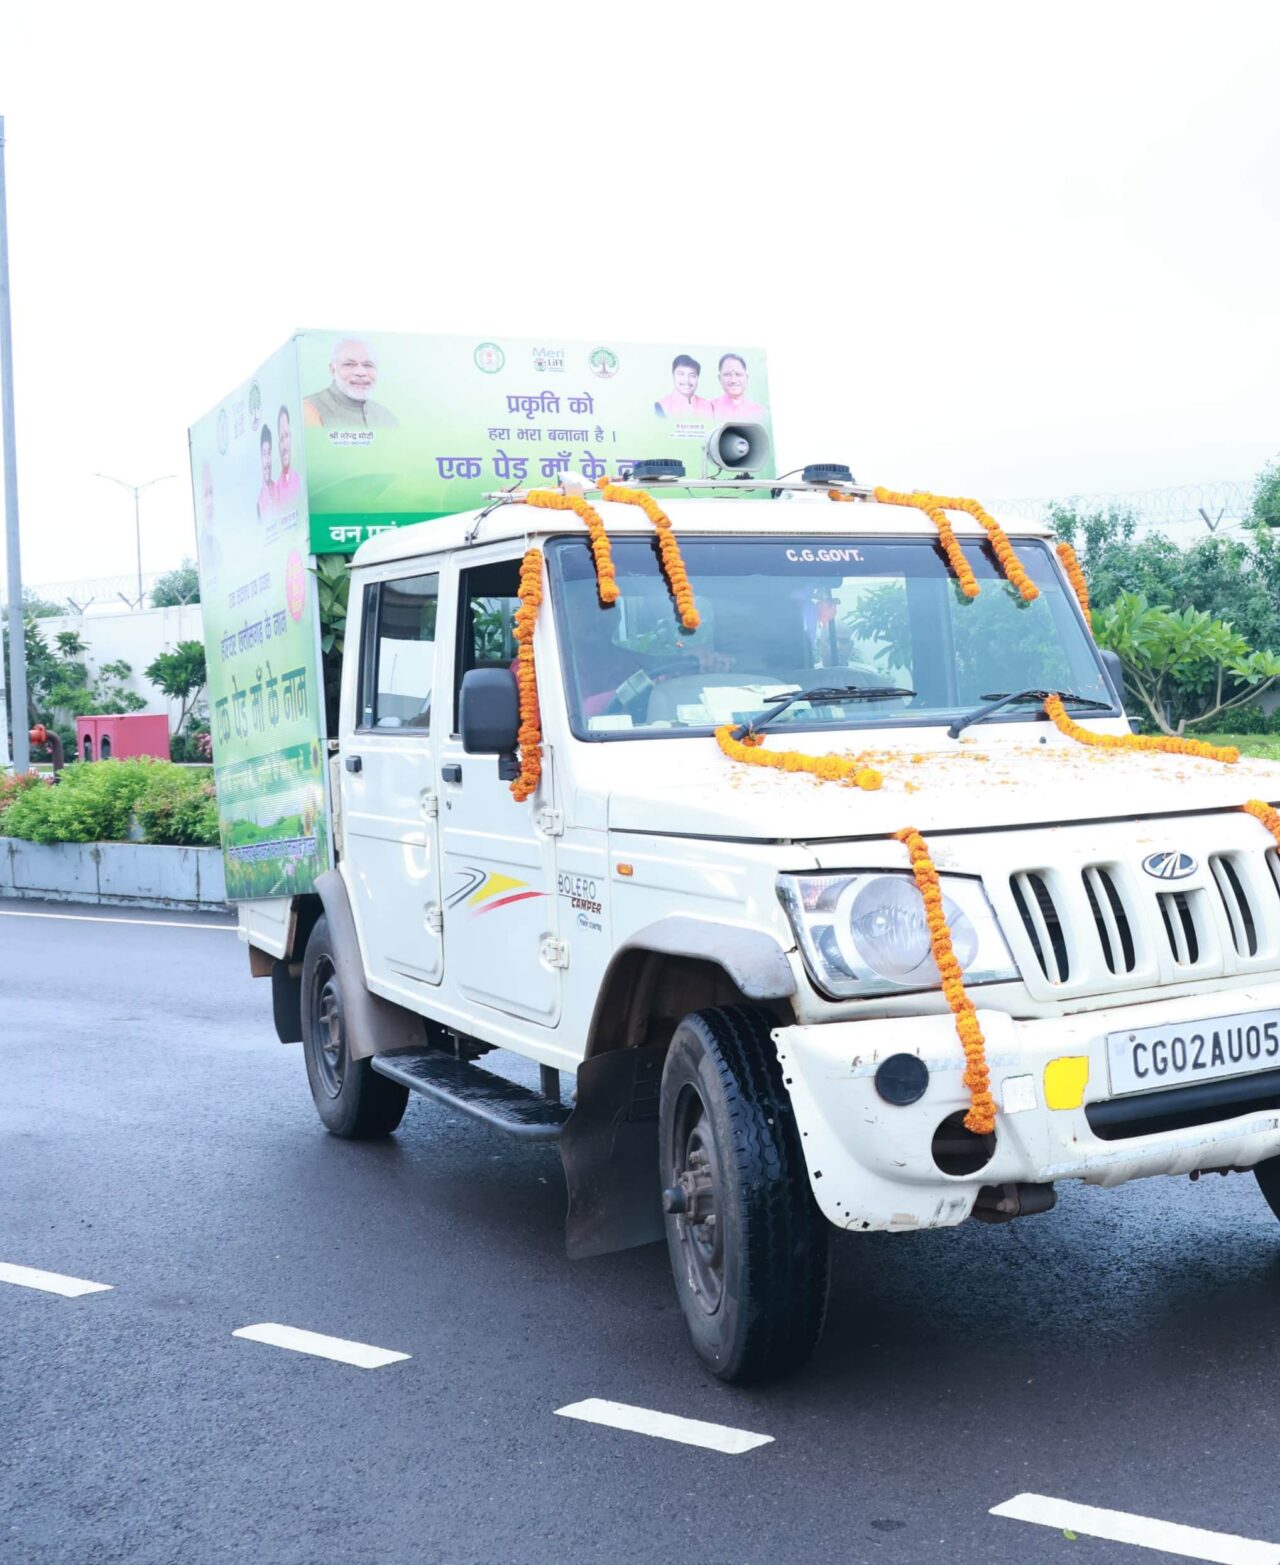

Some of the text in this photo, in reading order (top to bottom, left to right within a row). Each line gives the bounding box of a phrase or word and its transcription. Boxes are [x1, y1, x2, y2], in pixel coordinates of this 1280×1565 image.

[532, 347, 565, 358] Meri
[506, 390, 594, 420] प्रकृति को
[488, 428, 511, 442] हरा
[517, 428, 542, 442] भरा
[547, 429, 589, 443] बनाना
[594, 425, 605, 443] है
[436, 457, 482, 480] एक
[539, 450, 572, 479] माँ
[579, 450, 607, 480] के
[329, 526, 363, 543] वन
[785, 549, 864, 562] C.G.GOVT.
[264, 610, 271, 640] के
[273, 608, 287, 636] नाम
[215, 660, 308, 746] एक पेड़ माँ के नाम
[558, 873, 597, 900] BOLERO
[571, 897, 602, 915] CAMPER
